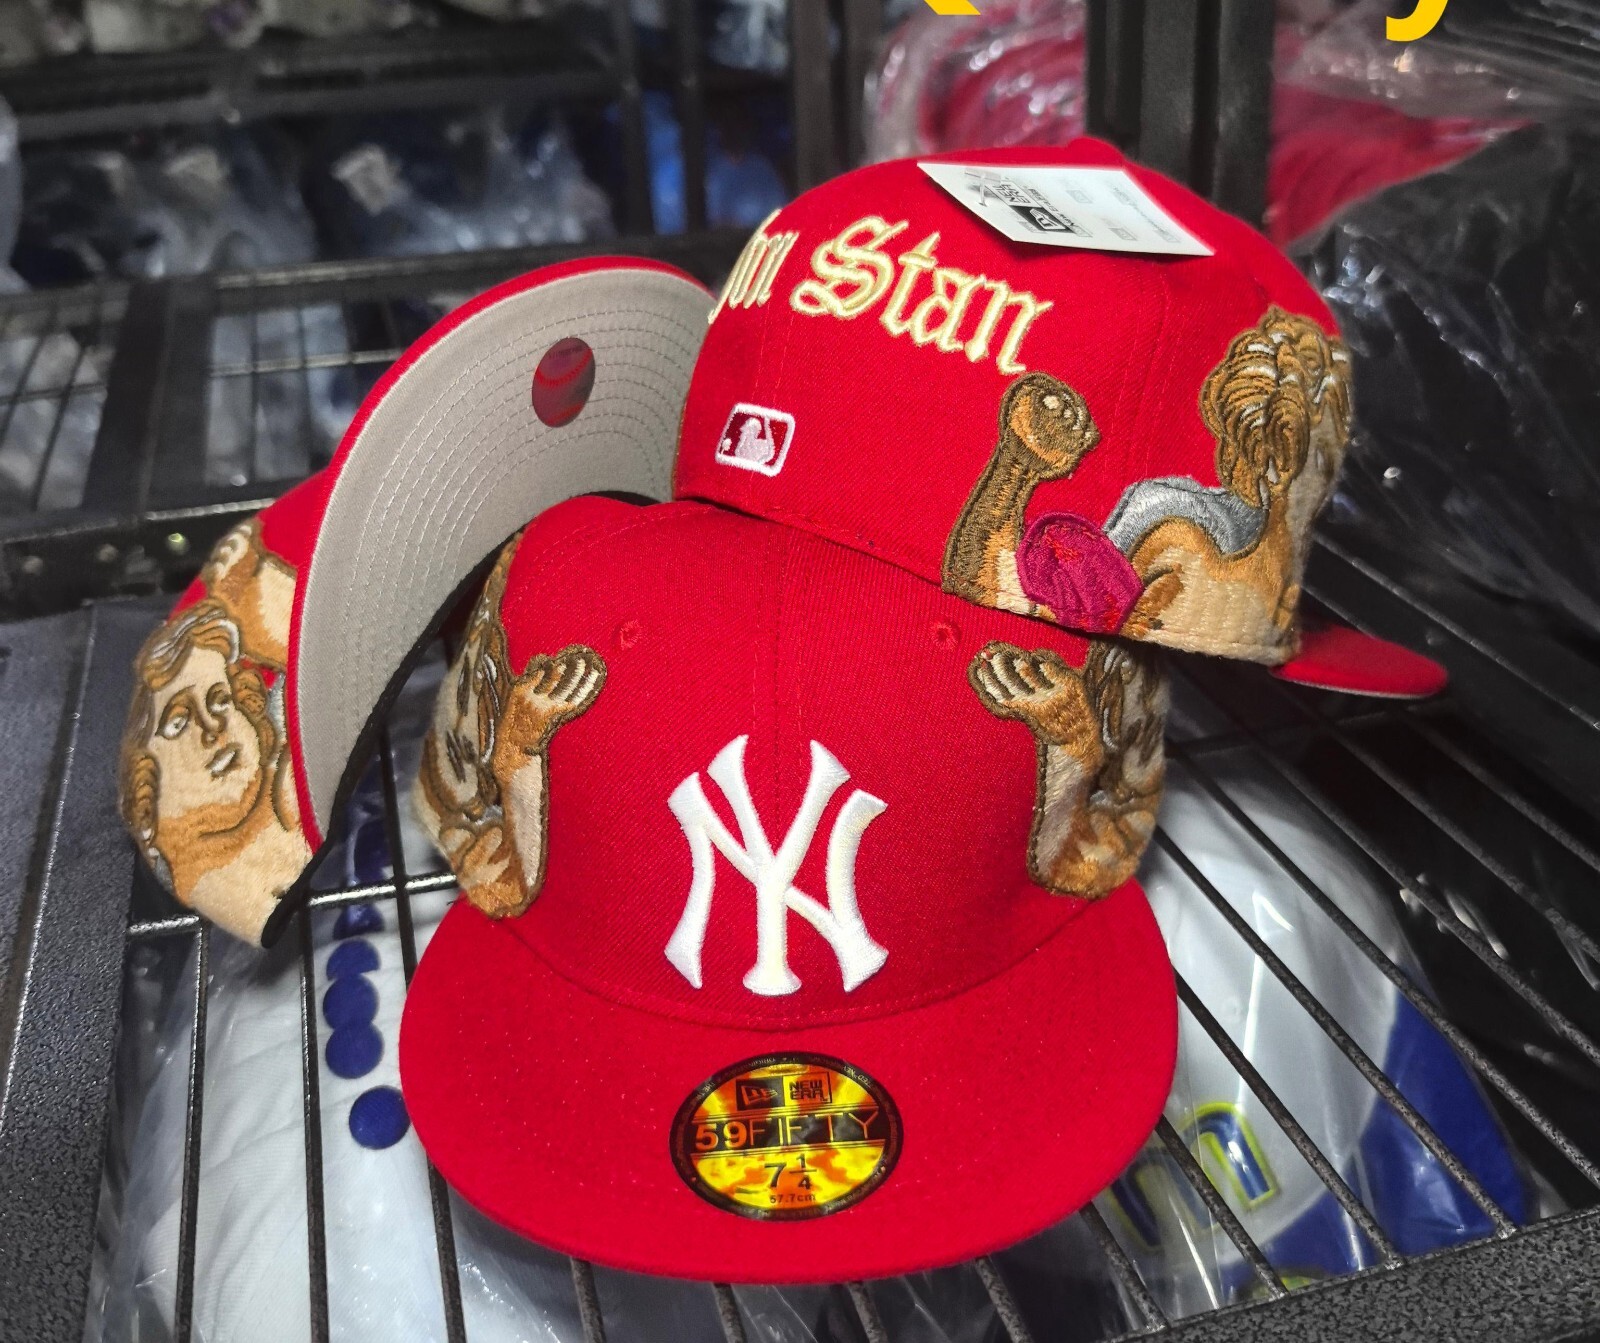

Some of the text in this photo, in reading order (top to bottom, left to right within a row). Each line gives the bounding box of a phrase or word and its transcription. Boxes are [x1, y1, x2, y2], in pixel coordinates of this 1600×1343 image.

[789, 215, 1053, 376] Stan
[789, 1080, 823, 1092] NEW
[790, 1089, 826, 1101] ERA
[694, 1110, 880, 1152] 59FIFTY
